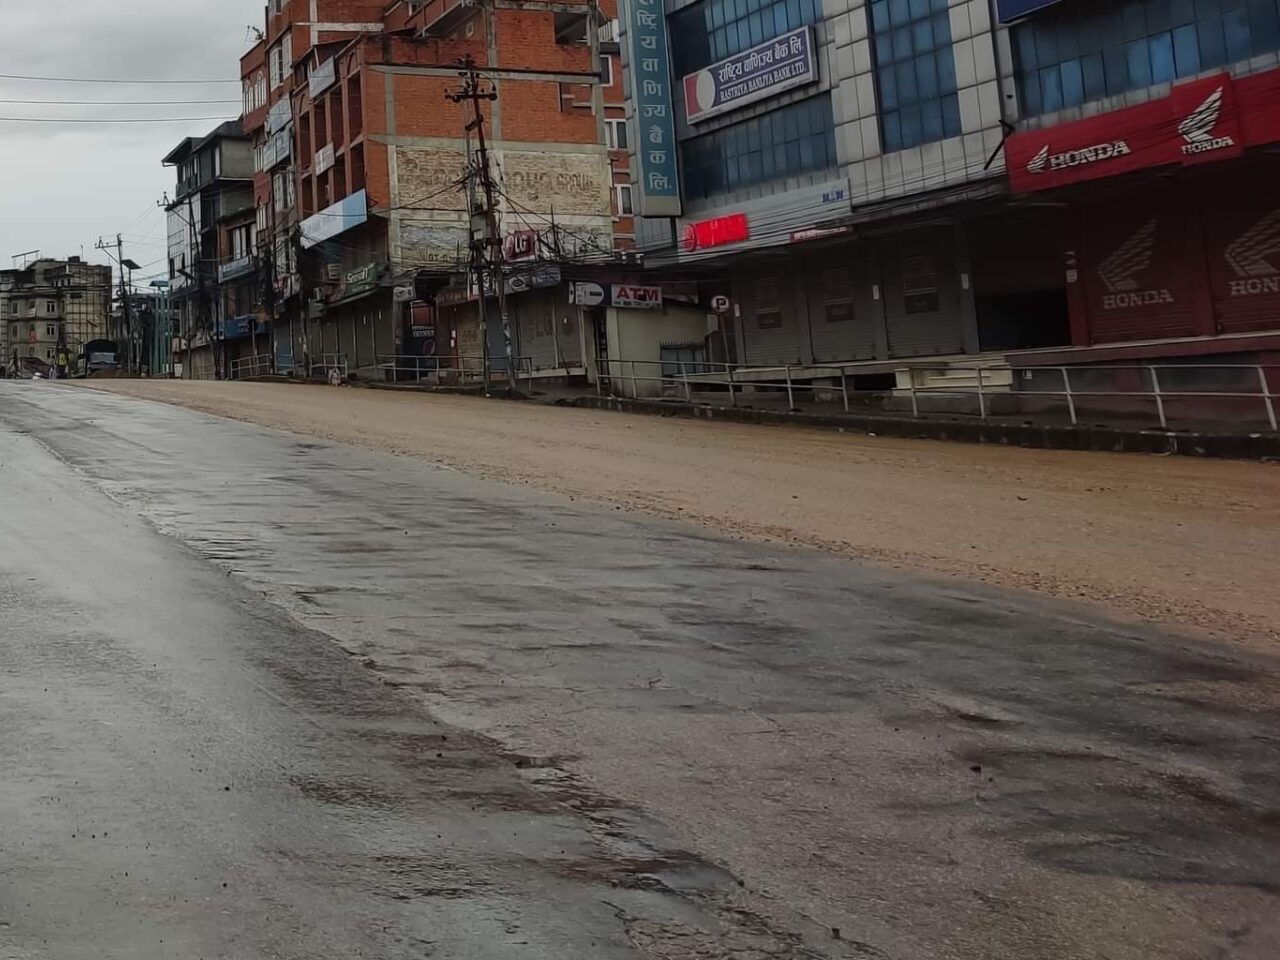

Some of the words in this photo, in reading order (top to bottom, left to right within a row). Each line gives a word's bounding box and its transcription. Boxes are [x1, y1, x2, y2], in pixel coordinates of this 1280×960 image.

[773, 67, 792, 82] BANK
[1180, 135, 1236, 155] HONDA
[1049, 140, 1133, 171] HONDA
[616, 287, 659, 302] ATM
[1227, 275, 1280, 297] HON
[1100, 289, 1176, 310] HONDA
